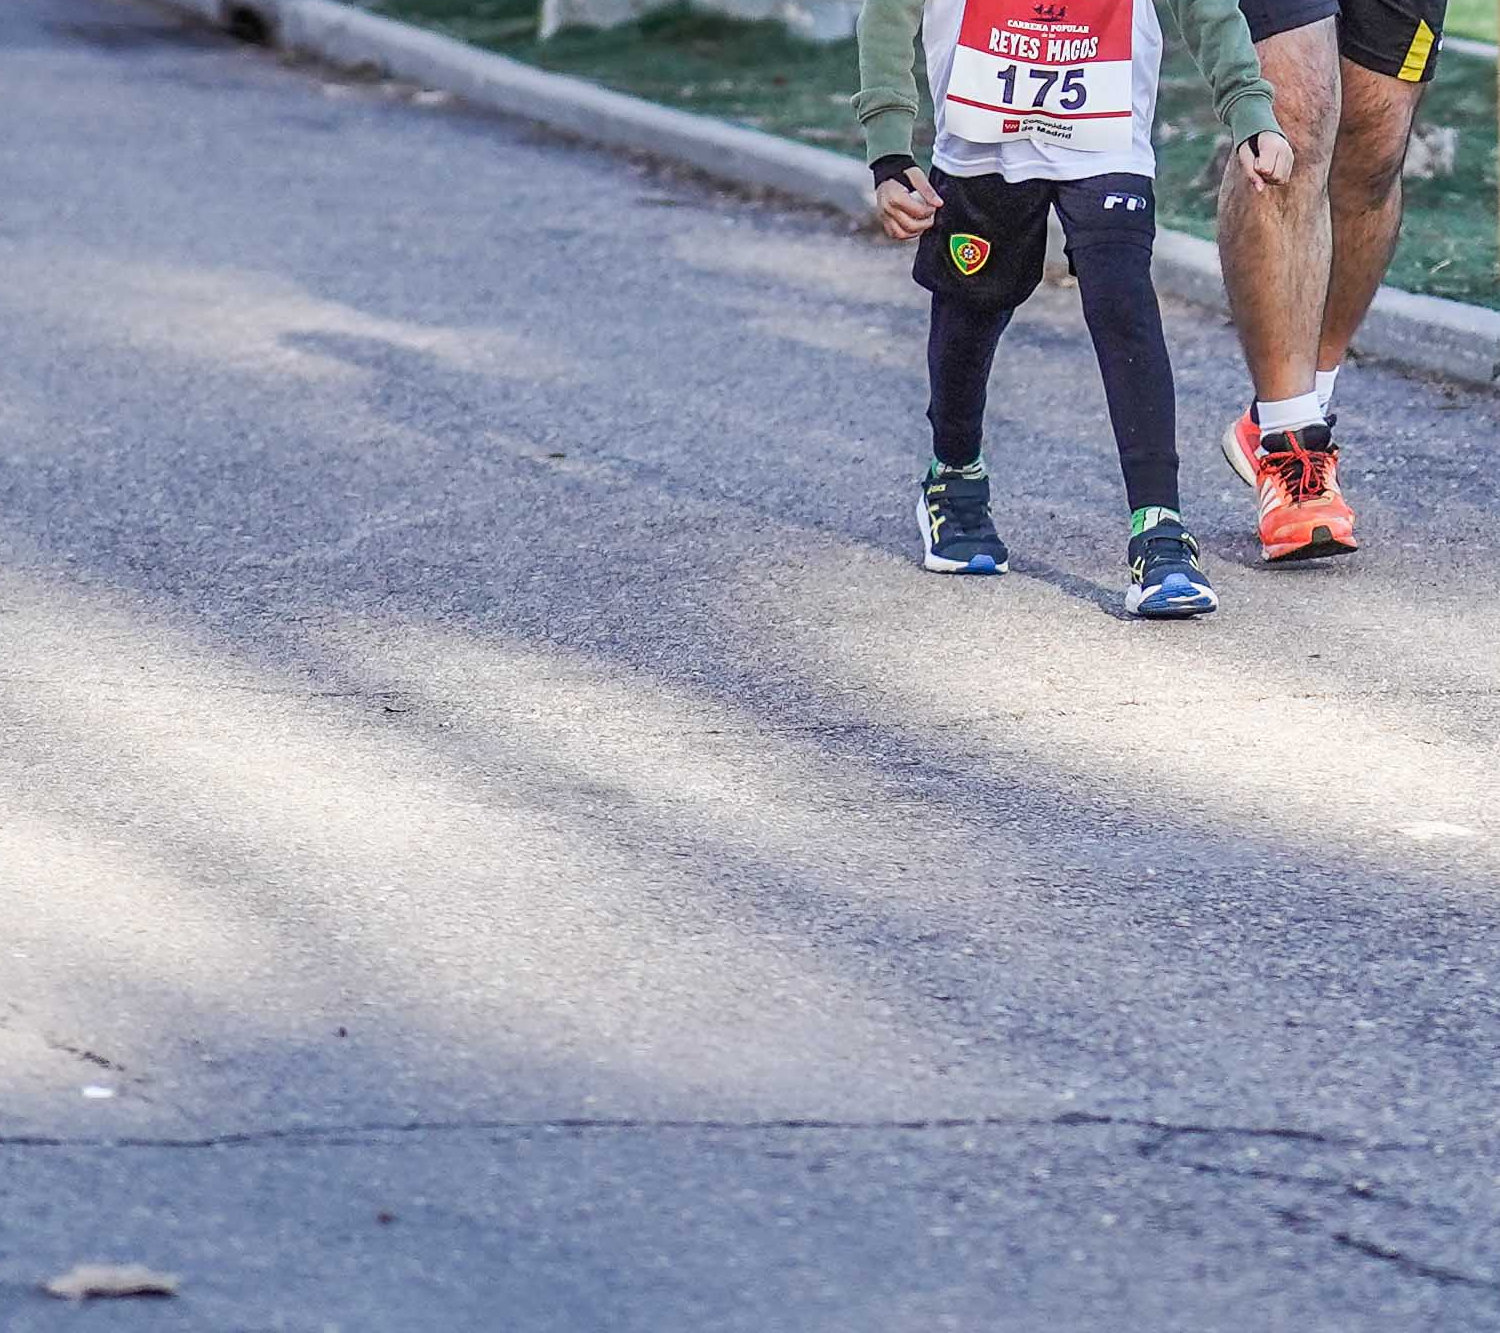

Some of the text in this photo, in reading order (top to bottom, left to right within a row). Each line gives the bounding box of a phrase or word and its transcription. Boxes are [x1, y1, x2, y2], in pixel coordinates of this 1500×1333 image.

[1007, 20, 1089, 33] CARRERA POPULAR
[988, 28, 1099, 62] REYES MAGOS
[997, 64, 1087, 110] 175
